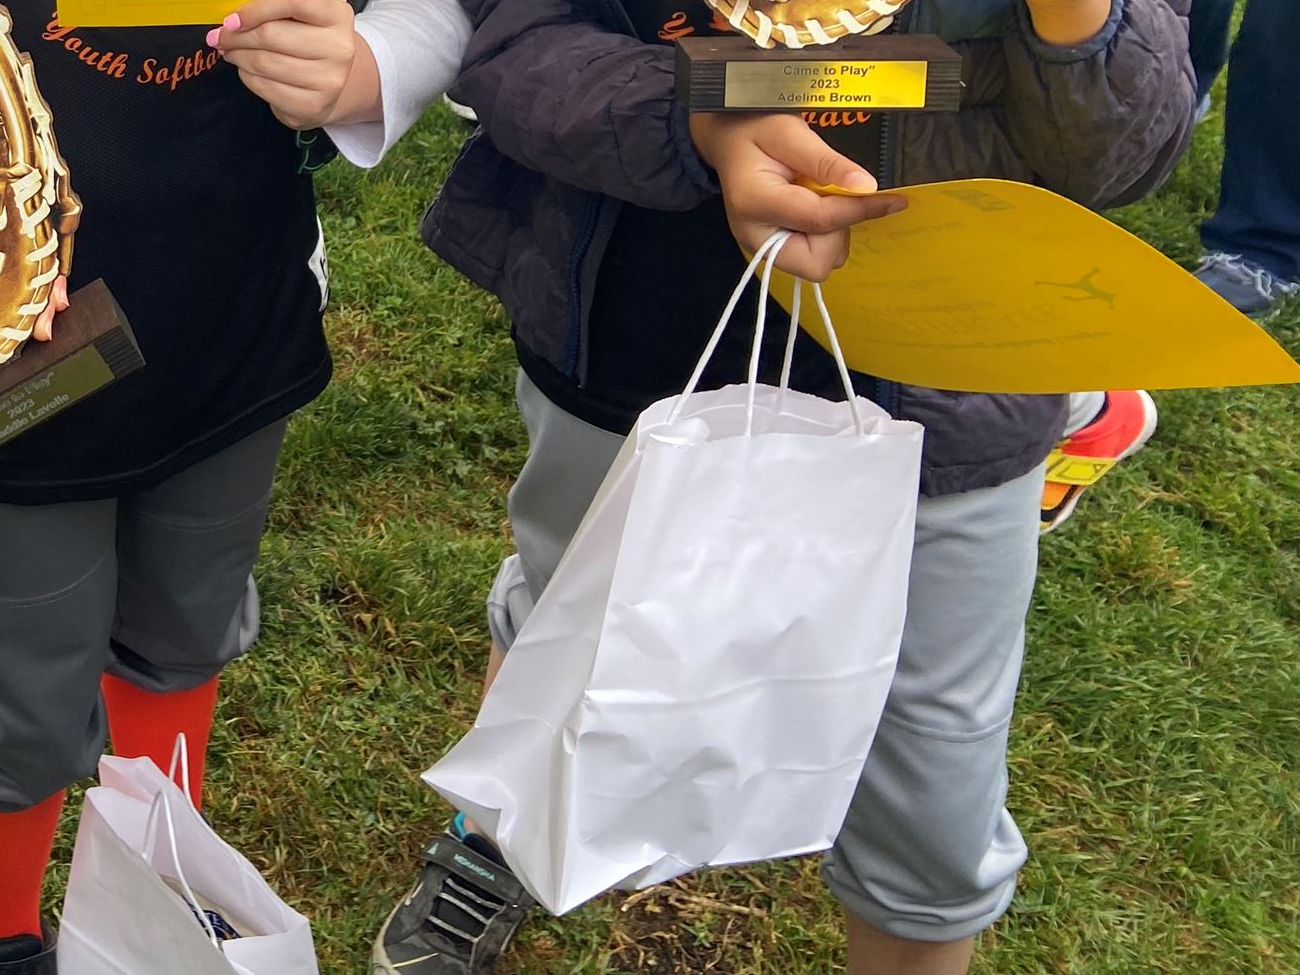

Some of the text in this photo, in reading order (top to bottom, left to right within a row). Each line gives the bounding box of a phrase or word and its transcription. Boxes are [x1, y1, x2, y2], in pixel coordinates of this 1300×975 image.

[136, 48, 221, 92] Softba
[824, 66, 836, 76] to
[810, 78, 840, 89] 2023
[777, 92, 872, 103] Adeline Brown
[7, 398, 36, 419] 2023
[29, 393, 70, 420] Lavelle
